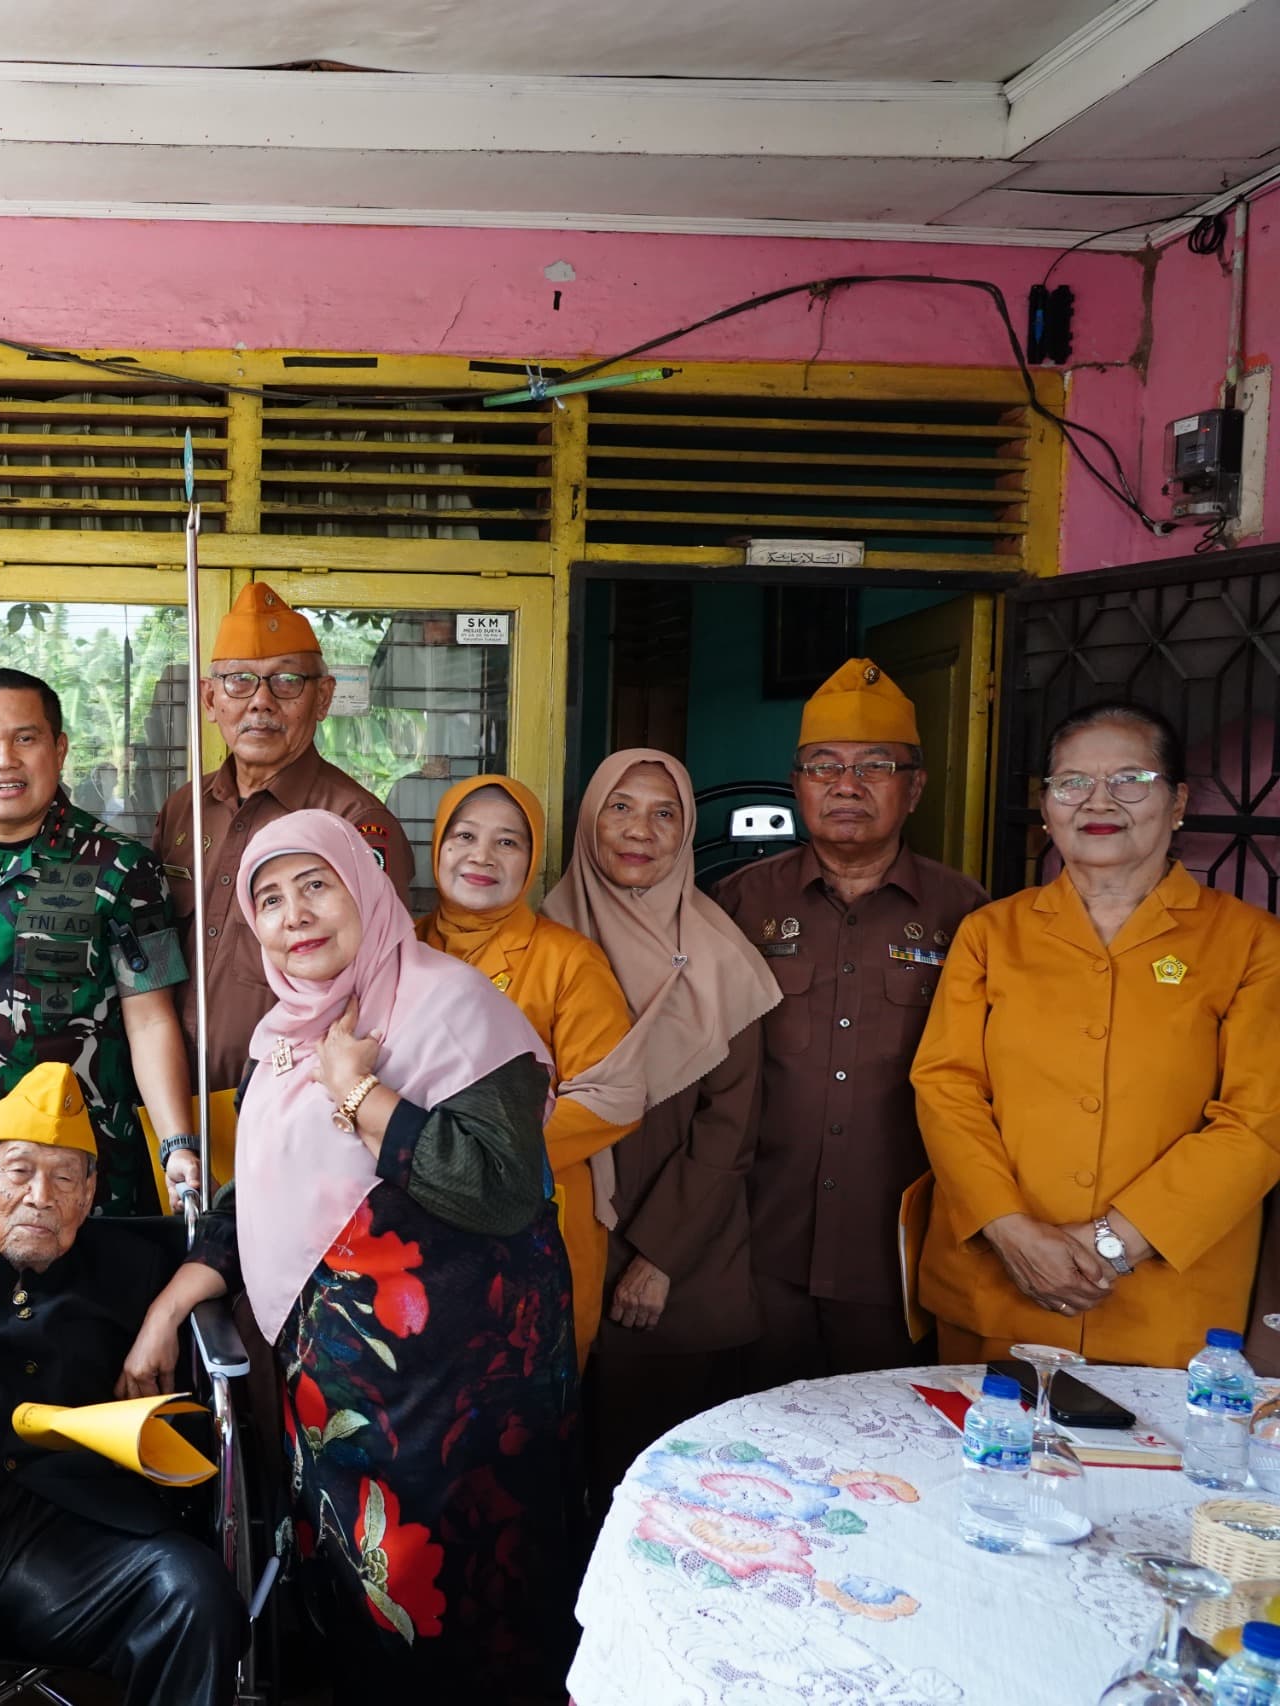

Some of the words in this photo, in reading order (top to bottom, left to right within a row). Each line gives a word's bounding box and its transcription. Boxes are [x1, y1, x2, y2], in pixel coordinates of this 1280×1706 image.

[467, 618, 498, 628] SKM
[26, 915, 56, 931] TNI
[64, 917, 90, 934] AD
